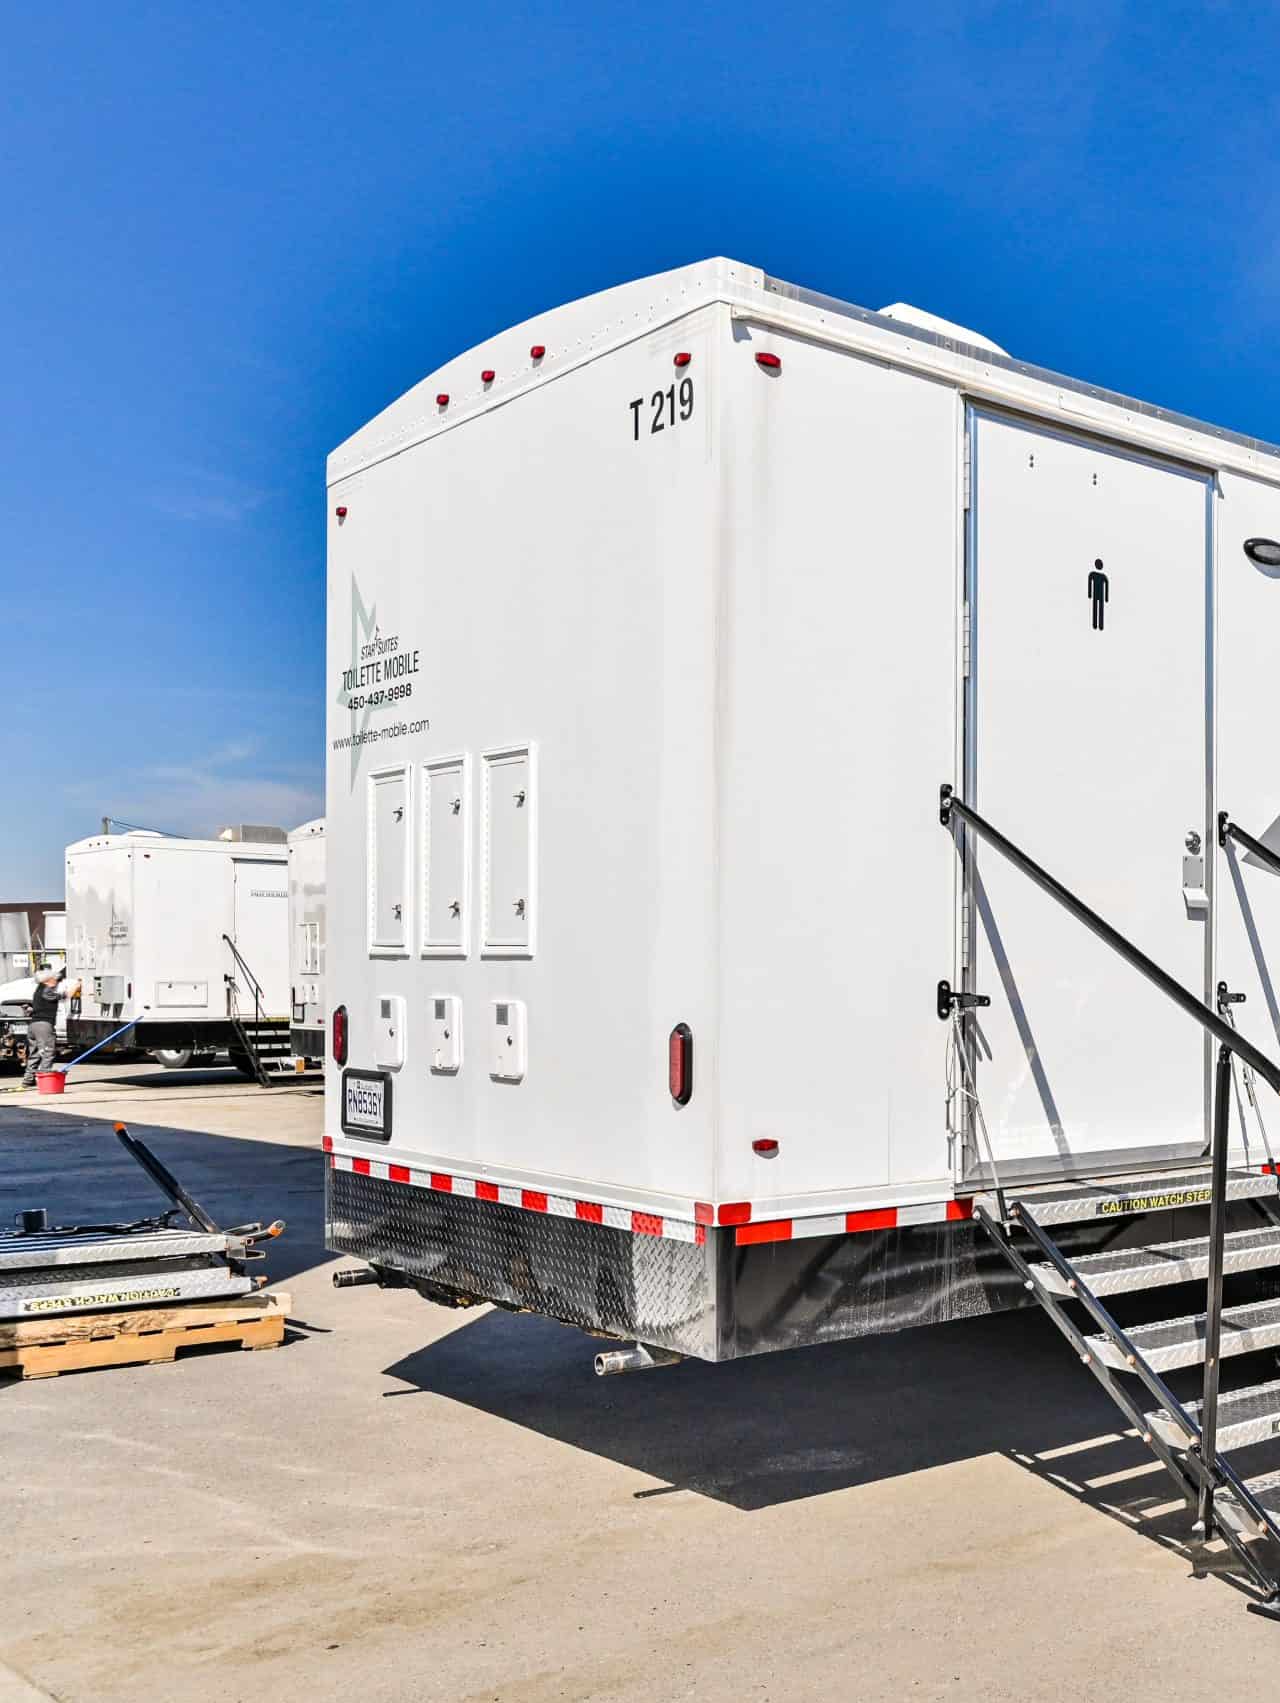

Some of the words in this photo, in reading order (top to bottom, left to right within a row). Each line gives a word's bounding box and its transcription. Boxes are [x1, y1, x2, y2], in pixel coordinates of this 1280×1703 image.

[629, 398, 644, 441] T
[651, 377, 694, 434] 219
[361, 642, 376, 661] STAR
[376, 636, 399, 656] SUITES
[342, 661, 382, 692] TOILETTE
[384, 650, 420, 681] MOBILE
[347, 683, 412, 710] 450-437-9998
[332, 719, 430, 751] www.toilette-mobile.com
[1102, 1198, 1147, 1213] CAUTION
[1150, 1193, 1184, 1207] WATCH
[1186, 1189, 1212, 1202] STEP
